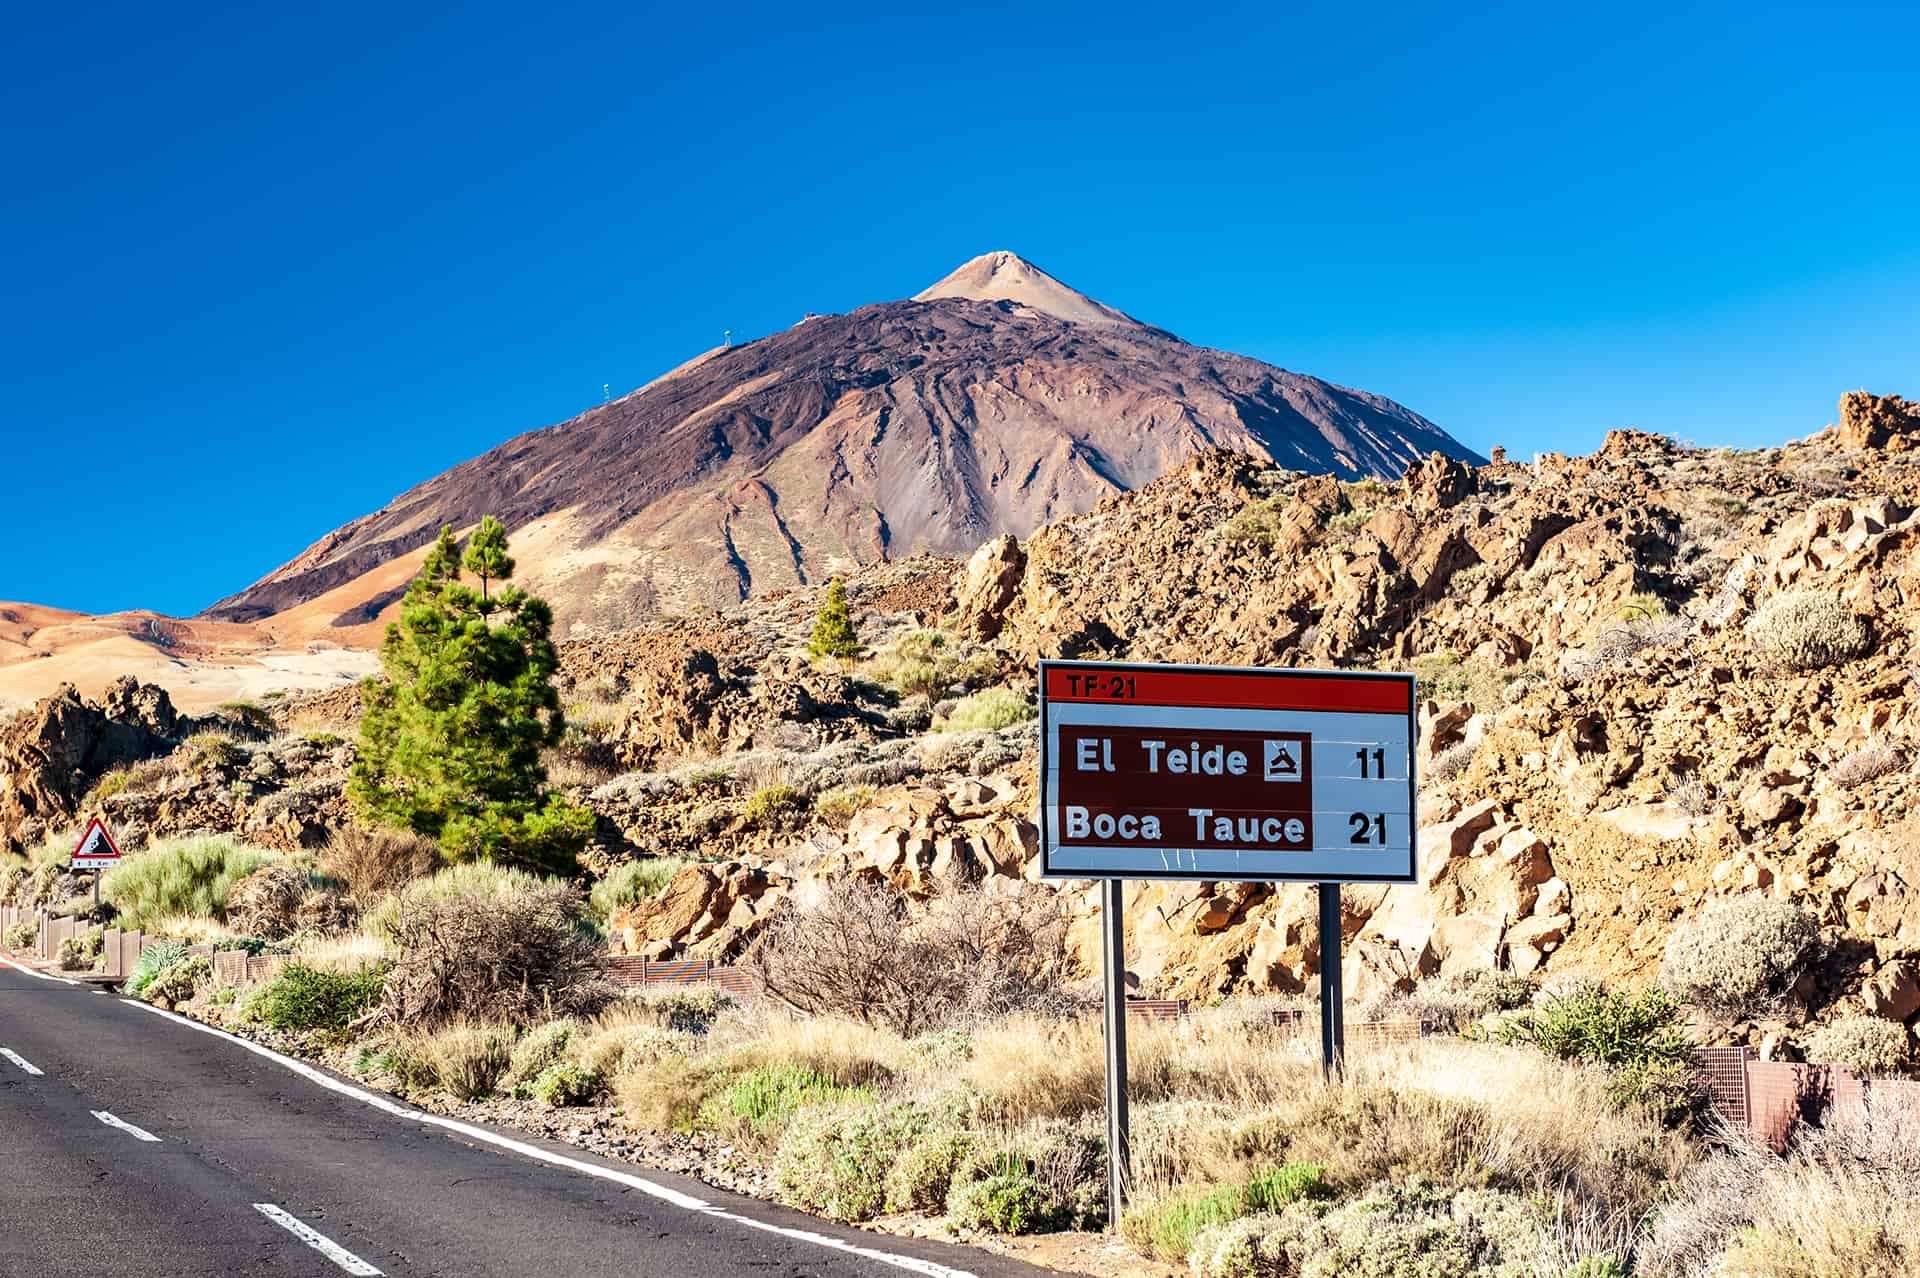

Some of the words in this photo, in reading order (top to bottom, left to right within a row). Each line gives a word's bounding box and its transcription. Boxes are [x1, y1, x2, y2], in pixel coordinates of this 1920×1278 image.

[1076, 738, 1116, 772] El
[1141, 740, 1248, 775] Teide
[1356, 748, 1385, 779] 11
[1065, 805, 1162, 840] Boca
[1188, 809, 1305, 842] Tauce
[1348, 812, 1387, 845] 21
